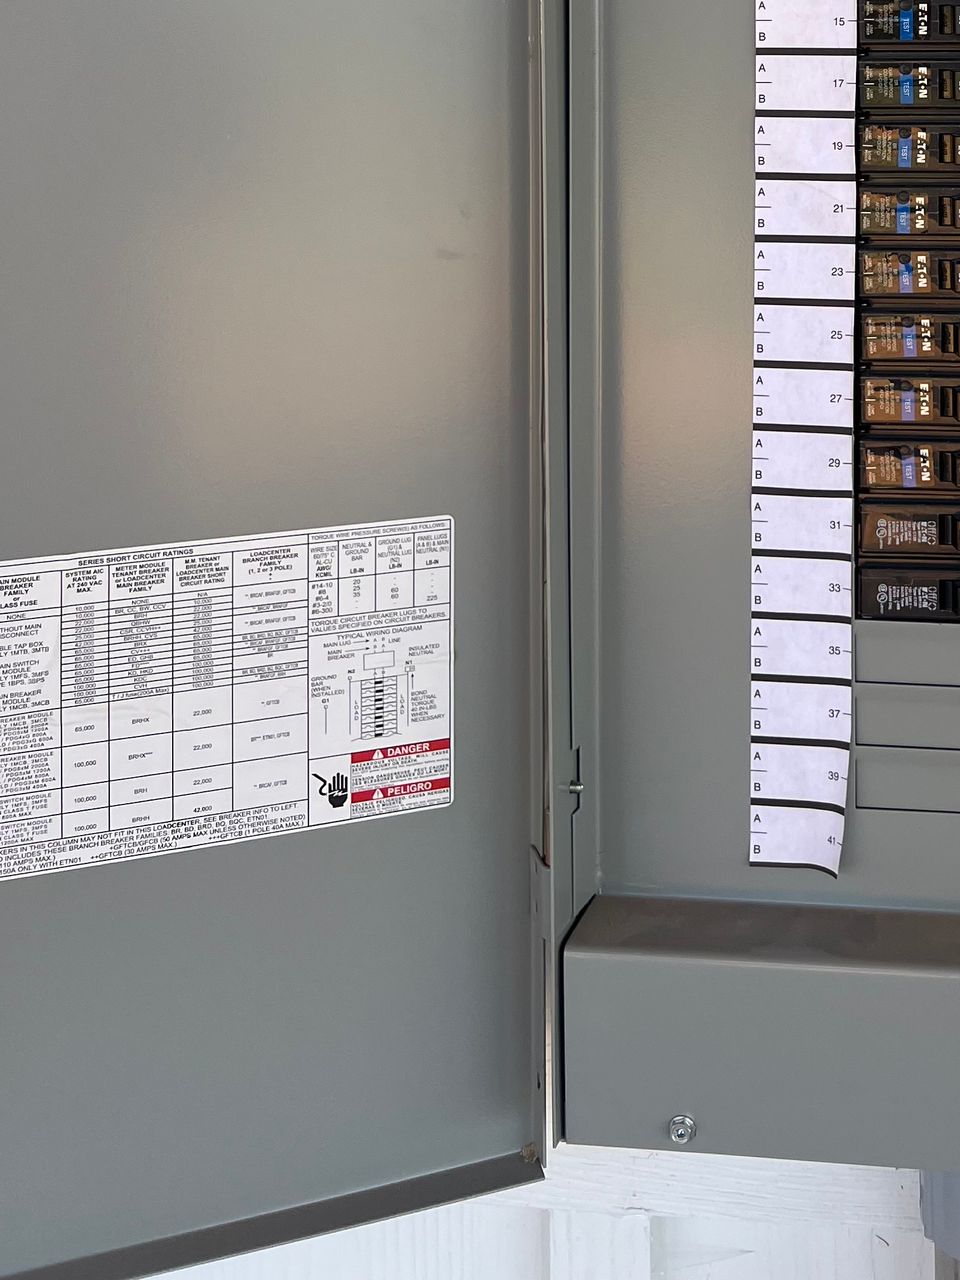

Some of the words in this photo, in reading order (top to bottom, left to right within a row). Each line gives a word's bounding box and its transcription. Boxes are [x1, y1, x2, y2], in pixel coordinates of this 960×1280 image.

[834, 18, 845, 26] 15
[833, 142, 842, 150] 19
[834, 204, 843, 213] 21
[830, 521, 840, 529] 31
[78, 558, 104, 566] SERIES
[106, 555, 131, 564] SHORT
[133, 552, 160, 561] CIRCUIT
[162, 548, 194, 557] RATINGS
[250, 548, 291, 557] LOADCENTER
[242, 556, 268, 564] BRANCH
[269, 553, 298, 561] BREAKER
[65, 570, 92, 578] SYSTEM
[137, 567, 169, 575] BREAKER
[829, 583, 840, 592] 33
[337, 632, 364, 640] TYPICAL
[366, 629, 390, 637] WIRING
[391, 625, 423, 634] DIAGRAM
[829, 646, 840, 655] 35
[387, 742, 430, 757] DANGER
[828, 771, 839, 781] 39
[387, 782, 432, 797] PELIGRO
[30, 843, 46, 851] THIS
[47, 838, 79, 849] COLUMN
[80, 836, 96, 844] MAY
[99, 833, 112, 841] NOT
[827, 836, 837, 845] 41
[39, 861, 58, 869] WITH
[59, 856, 82, 866] ETN01
